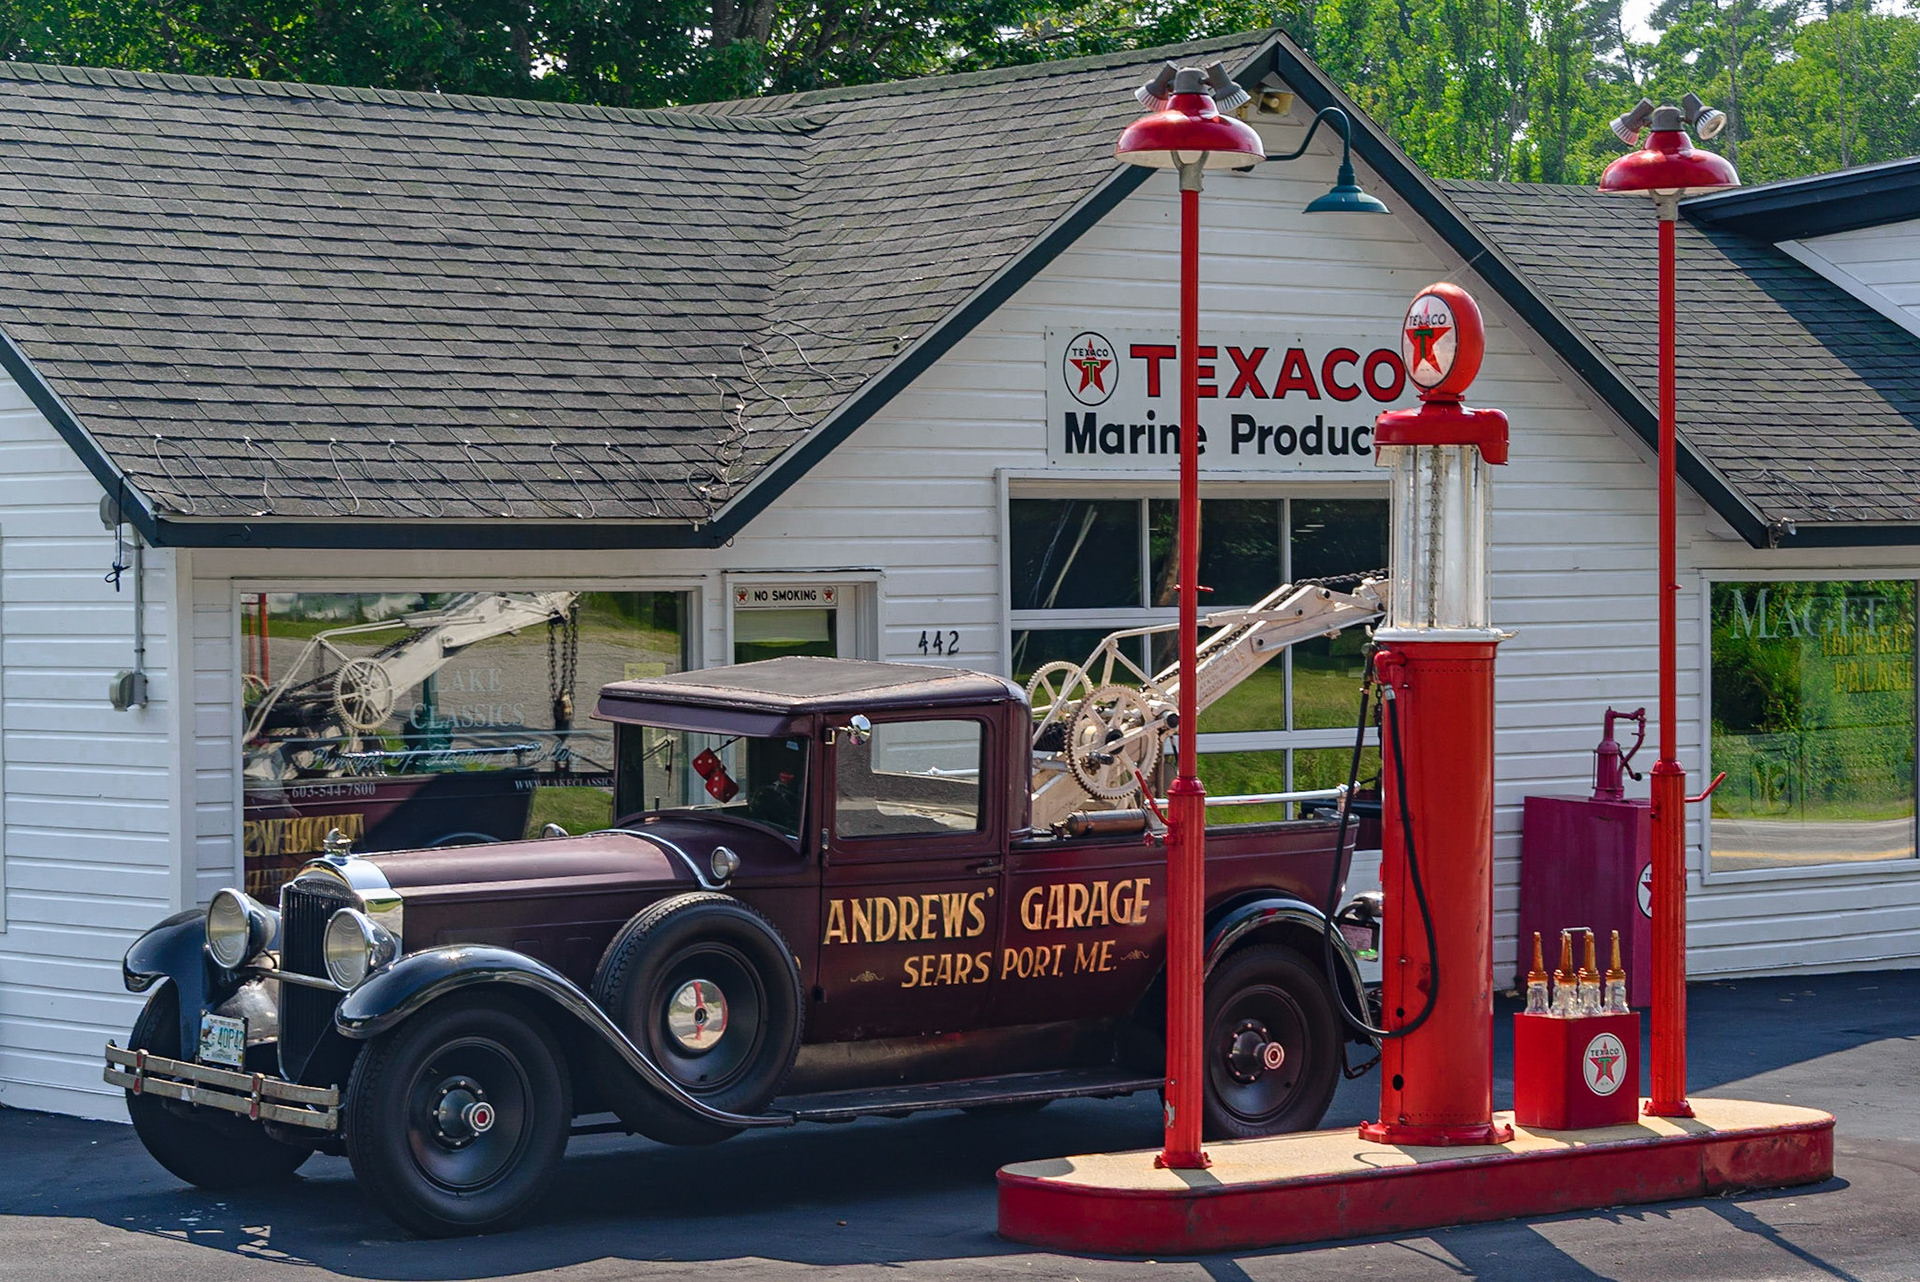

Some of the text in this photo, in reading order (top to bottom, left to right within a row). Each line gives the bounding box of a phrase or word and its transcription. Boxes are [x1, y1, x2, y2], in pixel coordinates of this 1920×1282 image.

[1409, 313, 1447, 327] TEXACO
[1072, 347, 1109, 357] TEXACO
[1130, 344, 1406, 402] TEXACO
[1230, 413, 1376, 456] Produc
[754, 590, 817, 601] NO SMOKING
[918, 630, 960, 656] 442
[431, 668, 505, 693] LAKE
[409, 702, 525, 729] CLASSICS
[291, 783, 376, 798] 603-544-7800
[1020, 877, 1151, 931] GARAGE
[901, 951, 992, 988] SEARS
[1073, 939, 1118, 974] ME.
[1591, 1048, 1619, 1057] TEXACO
